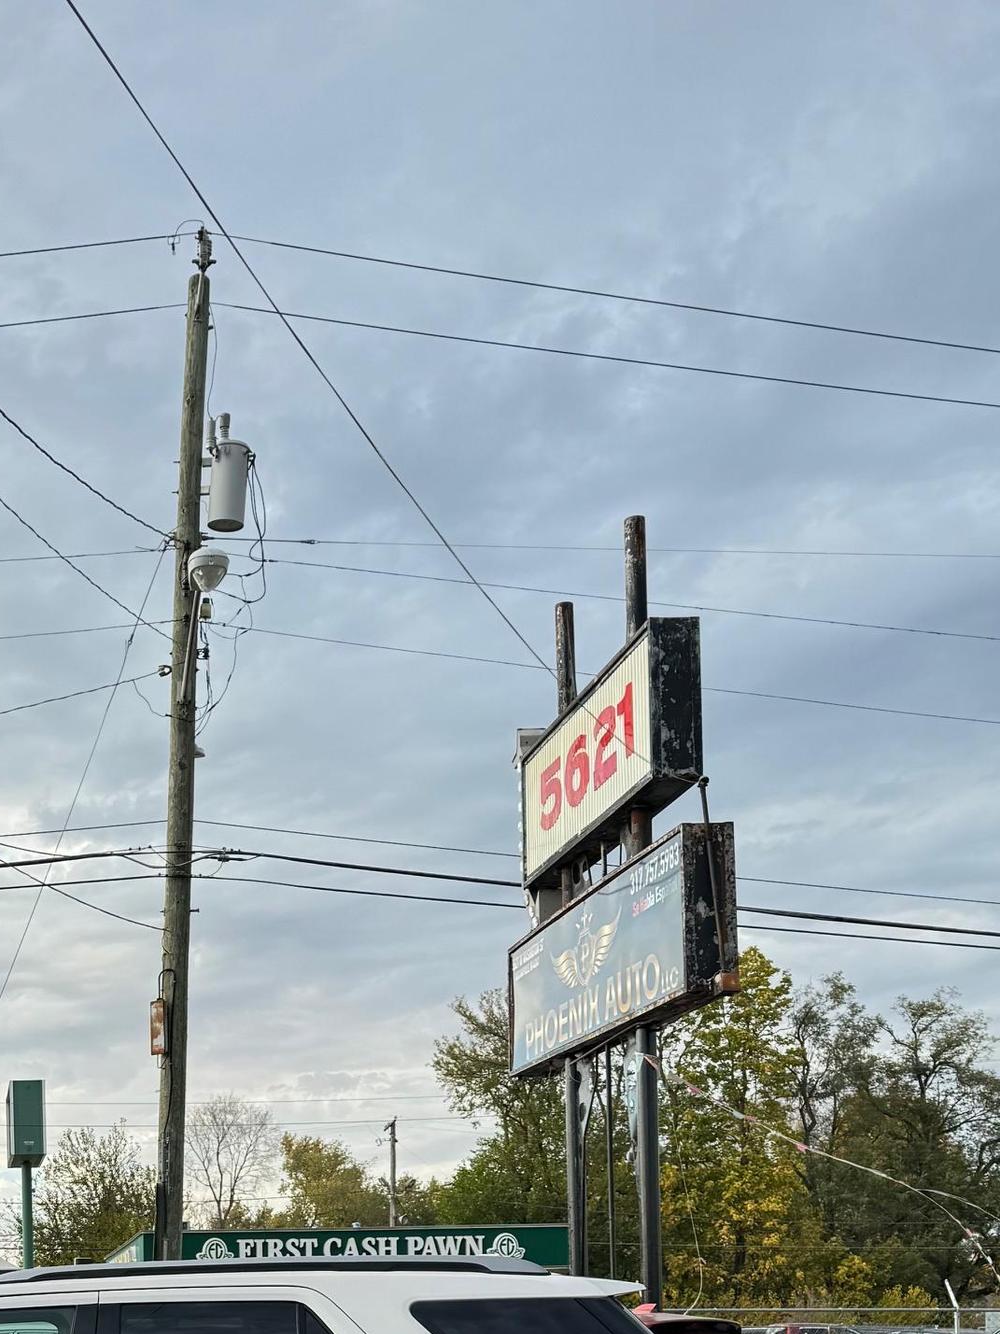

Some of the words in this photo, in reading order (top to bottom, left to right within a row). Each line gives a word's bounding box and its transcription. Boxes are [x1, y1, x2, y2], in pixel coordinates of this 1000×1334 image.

[540, 681, 635, 831] 5621
[630, 842, 679, 895] 317.757.5983
[525, 983, 600, 1060] PHOENIX
[605, 953, 661, 1020] AUTO
[661, 966, 679, 993] LLC
[236, 1237, 318, 1258] FIRST
[323, 1236, 399, 1257] CASH
[405, 1235, 485, 1257] PAWN
